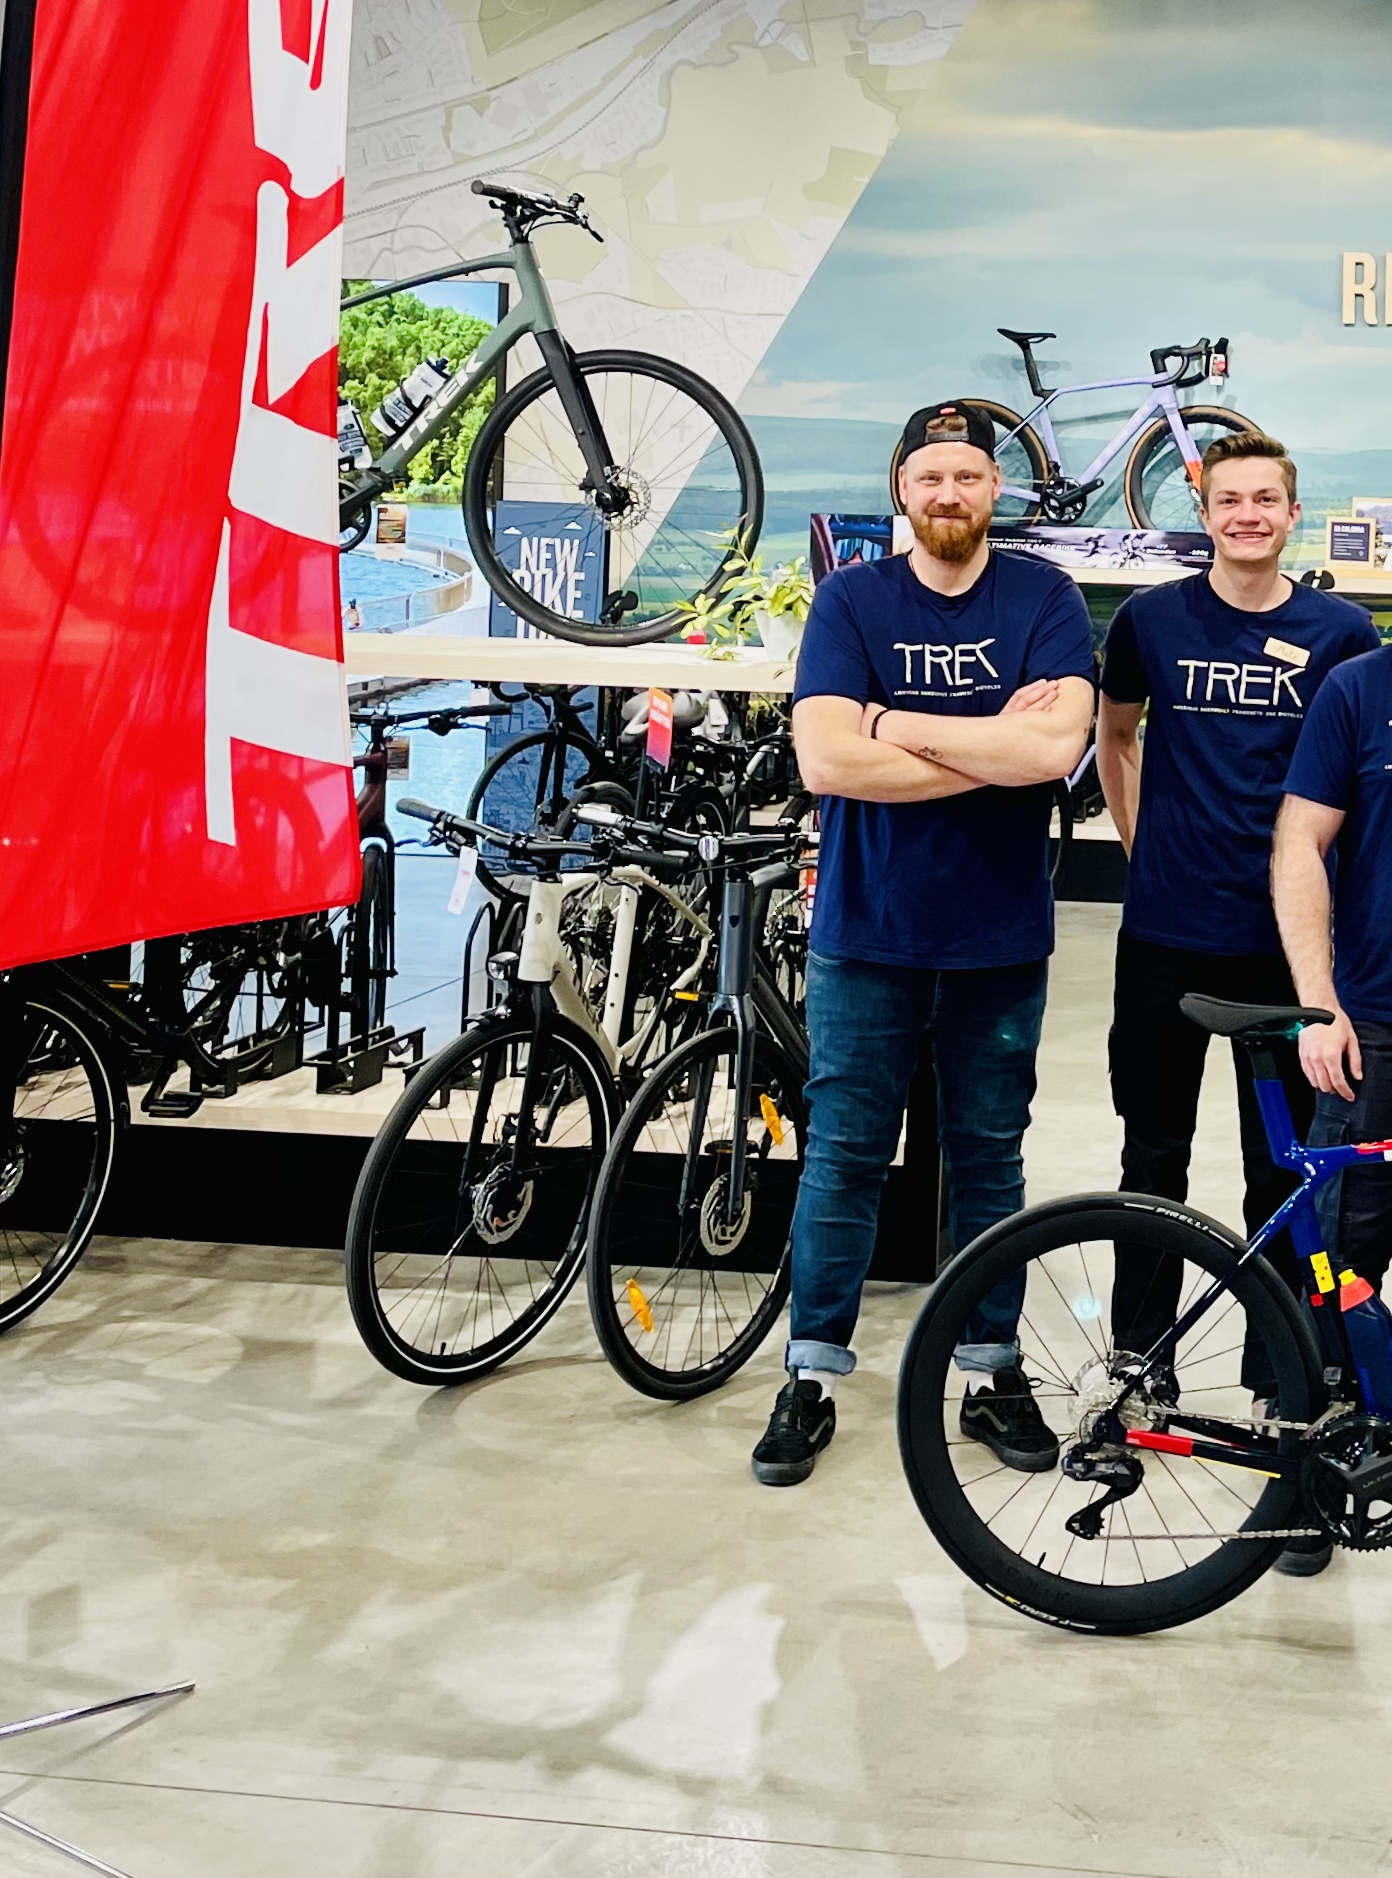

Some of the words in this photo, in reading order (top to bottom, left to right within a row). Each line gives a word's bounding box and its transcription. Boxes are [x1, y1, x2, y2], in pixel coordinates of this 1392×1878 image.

[392, 352, 484, 451] TREK
[519, 536, 580, 575] NEW
[893, 638, 999, 686] TREK
[1177, 659, 1306, 708] TREK
[1155, 1207, 1209, 1231] PIRELLI
